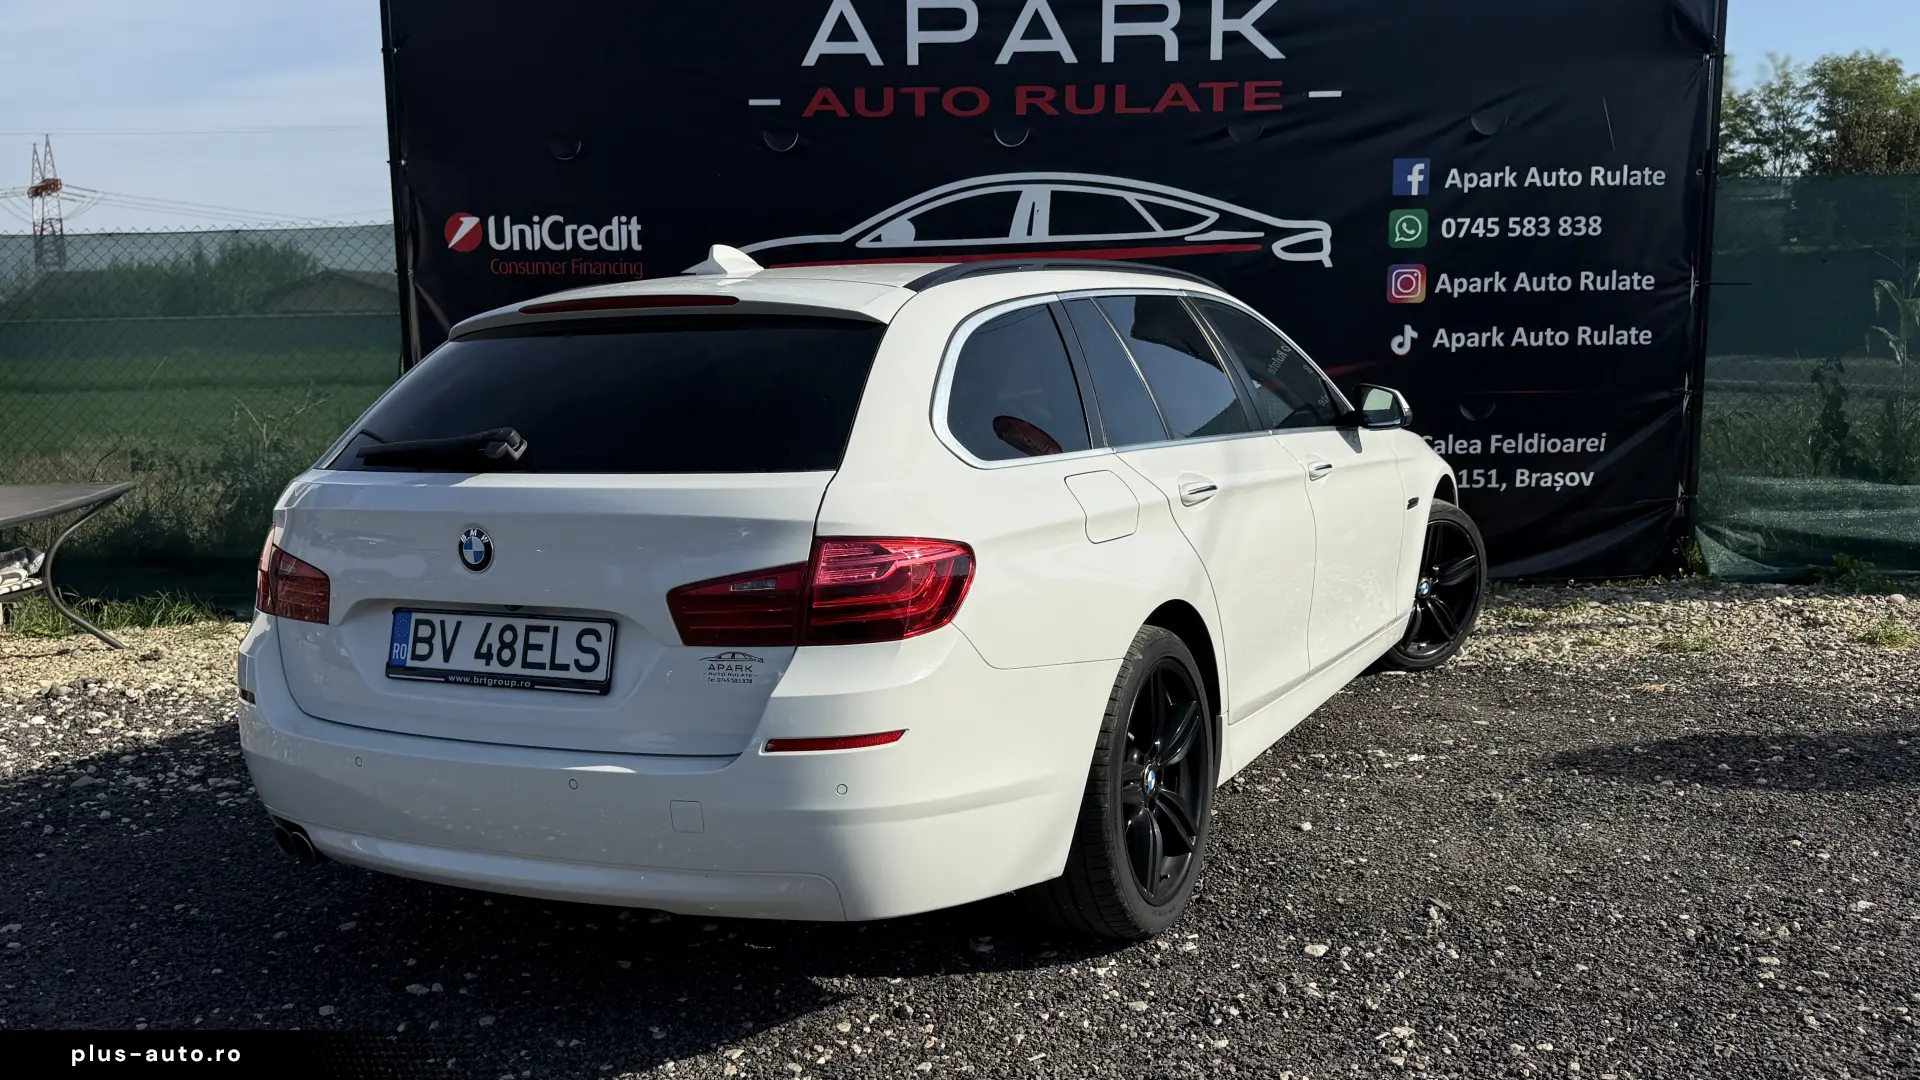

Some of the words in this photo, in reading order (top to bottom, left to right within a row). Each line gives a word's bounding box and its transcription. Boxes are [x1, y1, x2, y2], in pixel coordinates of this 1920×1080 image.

[802, 0, 1286, 66] APARK
[803, 86, 990, 117] AUTO
[1016, 81, 1282, 115] RULATE
[1445, 165, 1517, 193] Apark
[1524, 167, 1582, 187] Auto
[1590, 165, 1666, 187] Rulate
[488, 215, 642, 251] UniCredit
[1441, 217, 1500, 239] 0745
[1508, 217, 1550, 238] 583
[1558, 216, 1602, 237] 838
[490, 258, 566, 275] Consumer
[571, 259, 643, 279] Financing
[1435, 271, 1506, 298] Apark
[1514, 272, 1572, 292] Auto
[1580, 270, 1655, 291] Rulate
[1433, 326, 1504, 352] Apark
[1511, 327, 1569, 347] Auto
[1577, 325, 1652, 345] Rulate
[1491, 433, 1606, 453] Feldioarei
[1457, 469, 1507, 491] 151,
[1516, 468, 1594, 491] Brașov
[460, 529, 489, 543] BMW
[392, 643, 407, 660] RO
[411, 619, 461, 663] BV
[474, 622, 602, 673] 48ELS
[708, 664, 752, 673] APARK
[448, 674, 531, 688] www.brtgroup.ro
